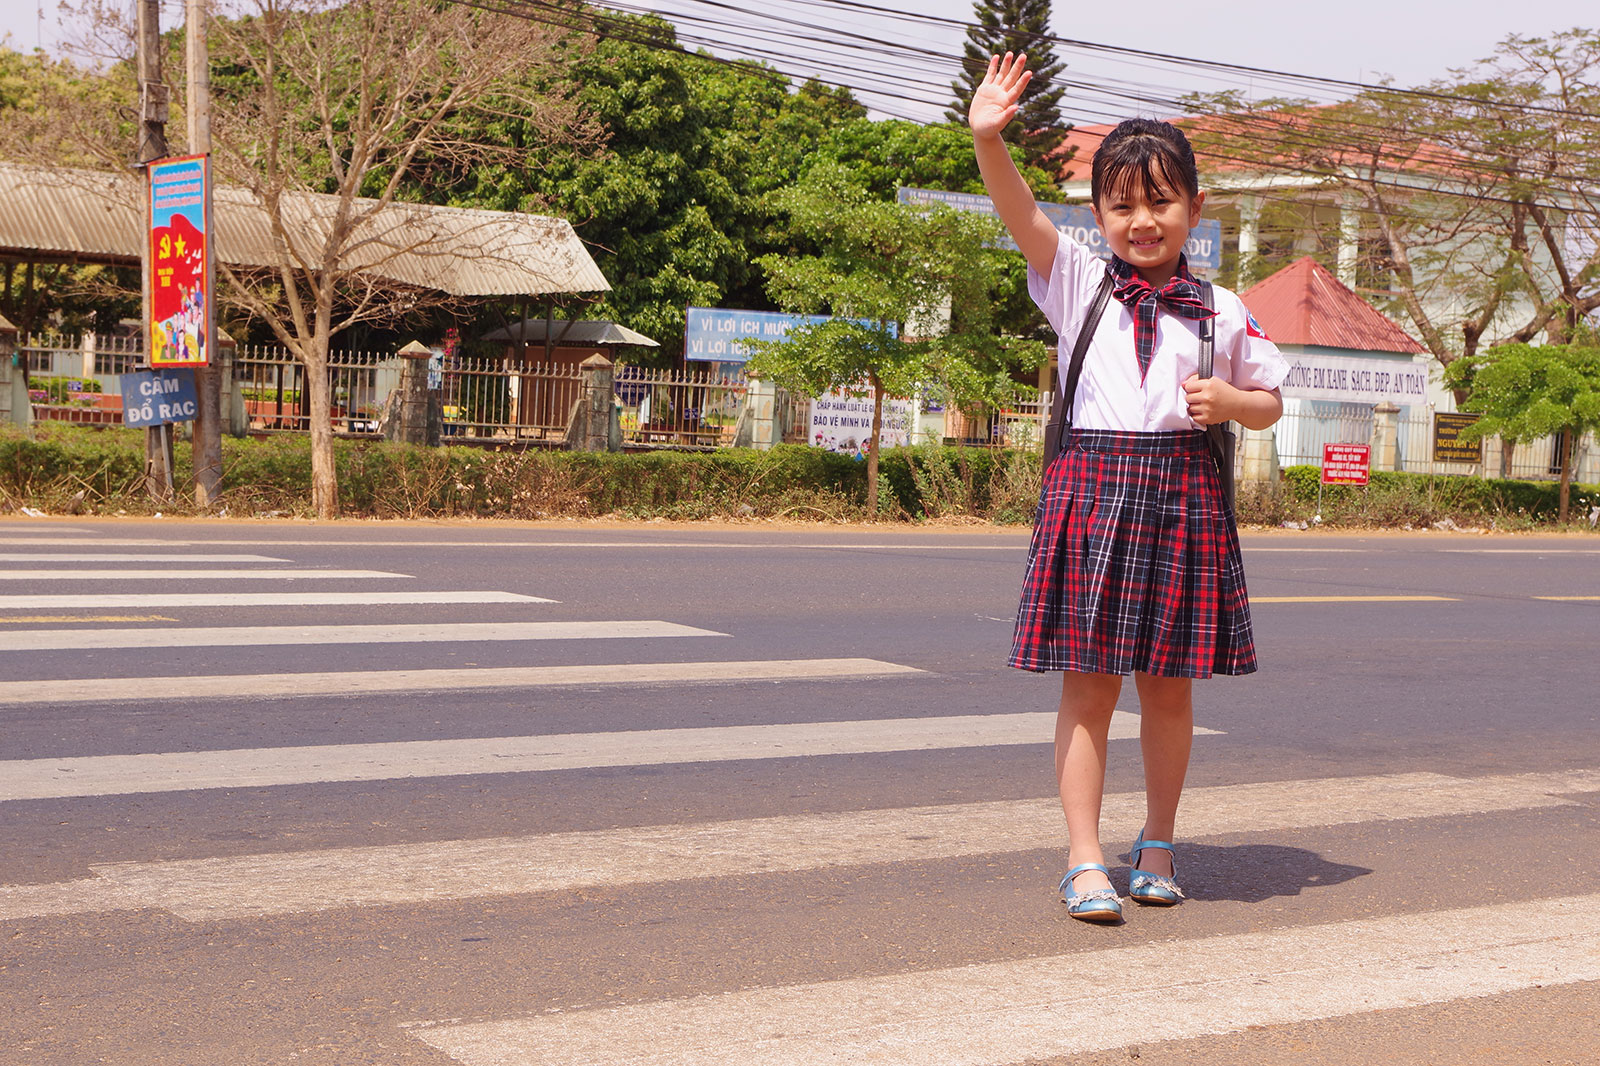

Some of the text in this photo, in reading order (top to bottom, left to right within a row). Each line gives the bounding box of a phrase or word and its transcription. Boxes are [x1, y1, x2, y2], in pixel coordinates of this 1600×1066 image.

[701, 316, 713, 332] VÌ
[717, 318, 735, 336] LỢI
[740, 318, 760, 334] ÍCH
[692, 338, 703, 353] VÌ
[708, 339, 726, 357] LỢI
[1314, 368, 1325, 388] EM
[1394, 373, 1404, 394] AN
[1406, 369, 1425, 395] TOÀN
[128, 398, 153, 422] ĐỔ
